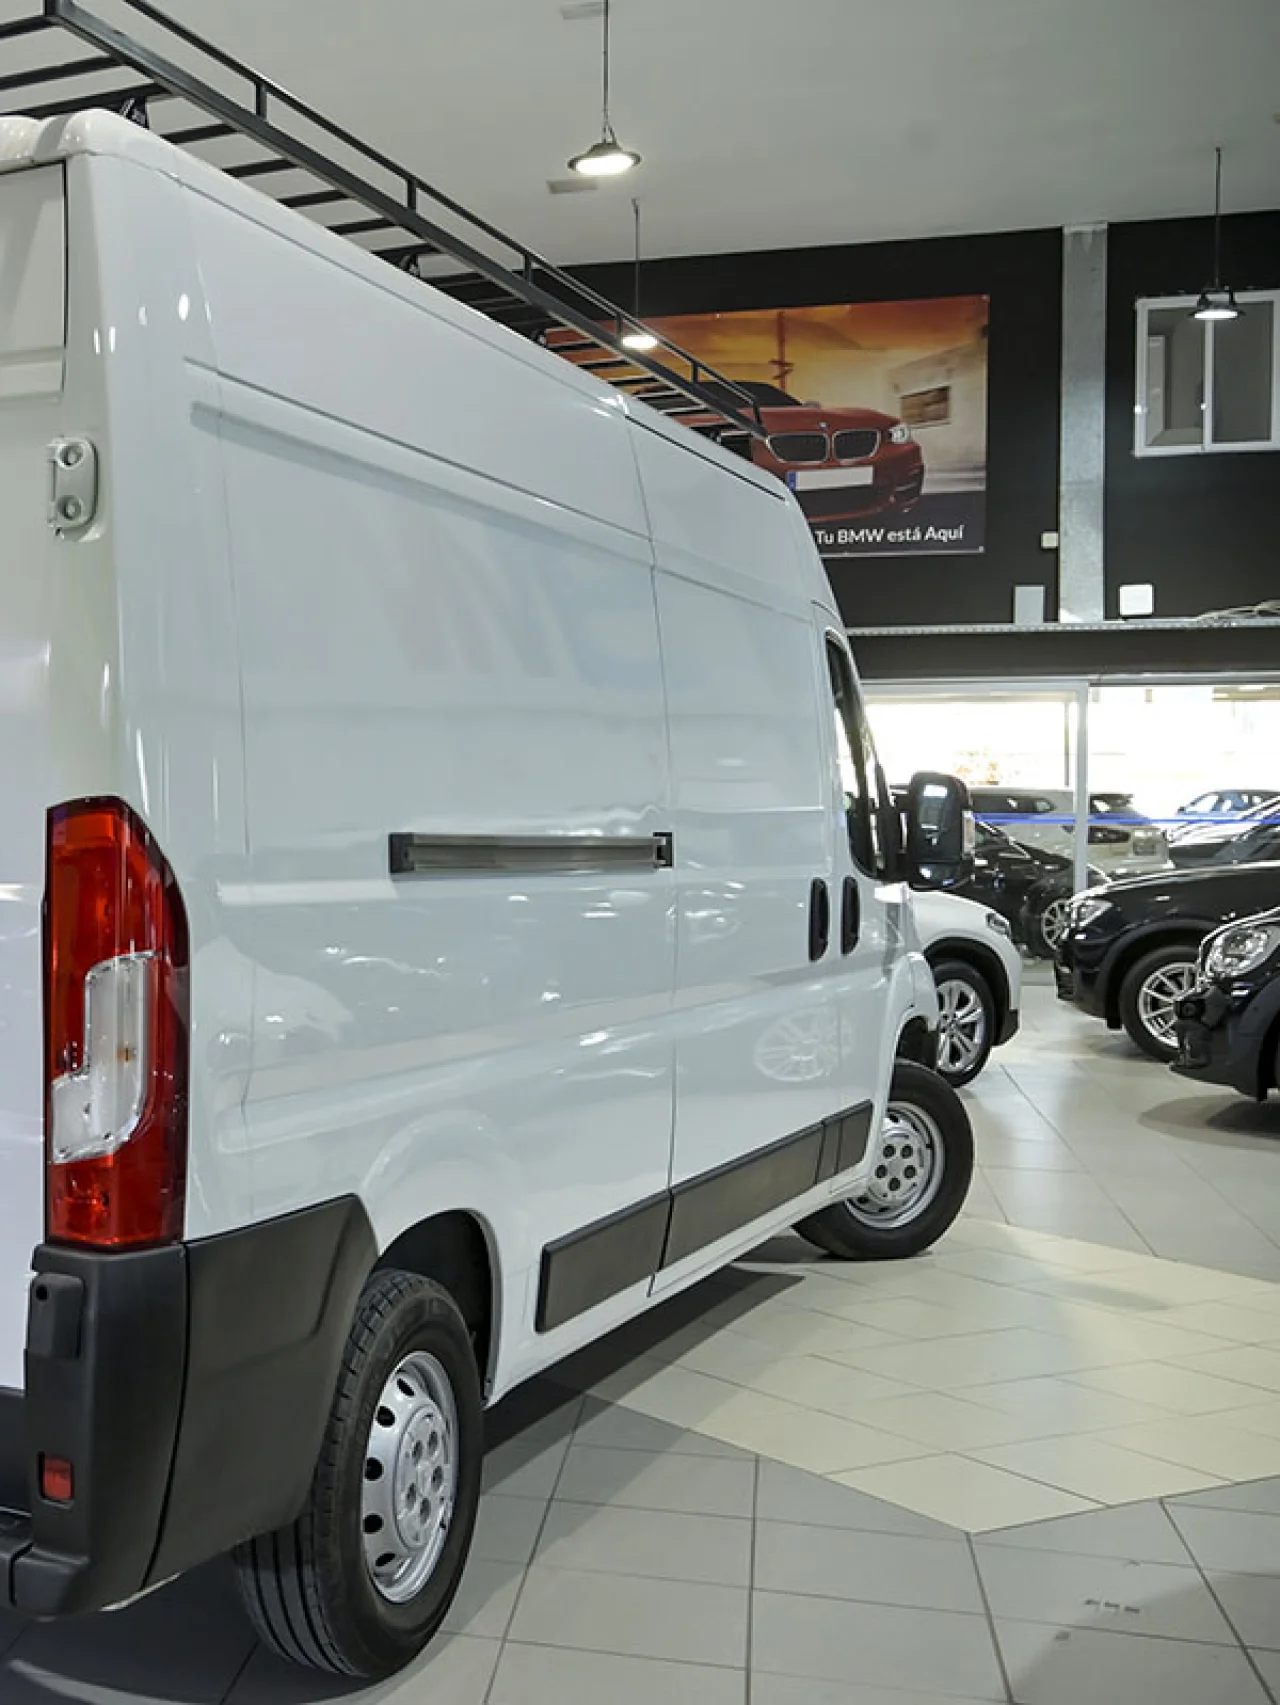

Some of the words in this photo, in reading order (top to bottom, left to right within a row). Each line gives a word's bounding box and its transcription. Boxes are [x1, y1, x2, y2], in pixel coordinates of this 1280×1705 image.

[815, 530, 835, 545] Tu
[837, 528, 884, 543] BMW
[887, 526, 922, 542] está
[924, 524, 965, 543] Aquí
